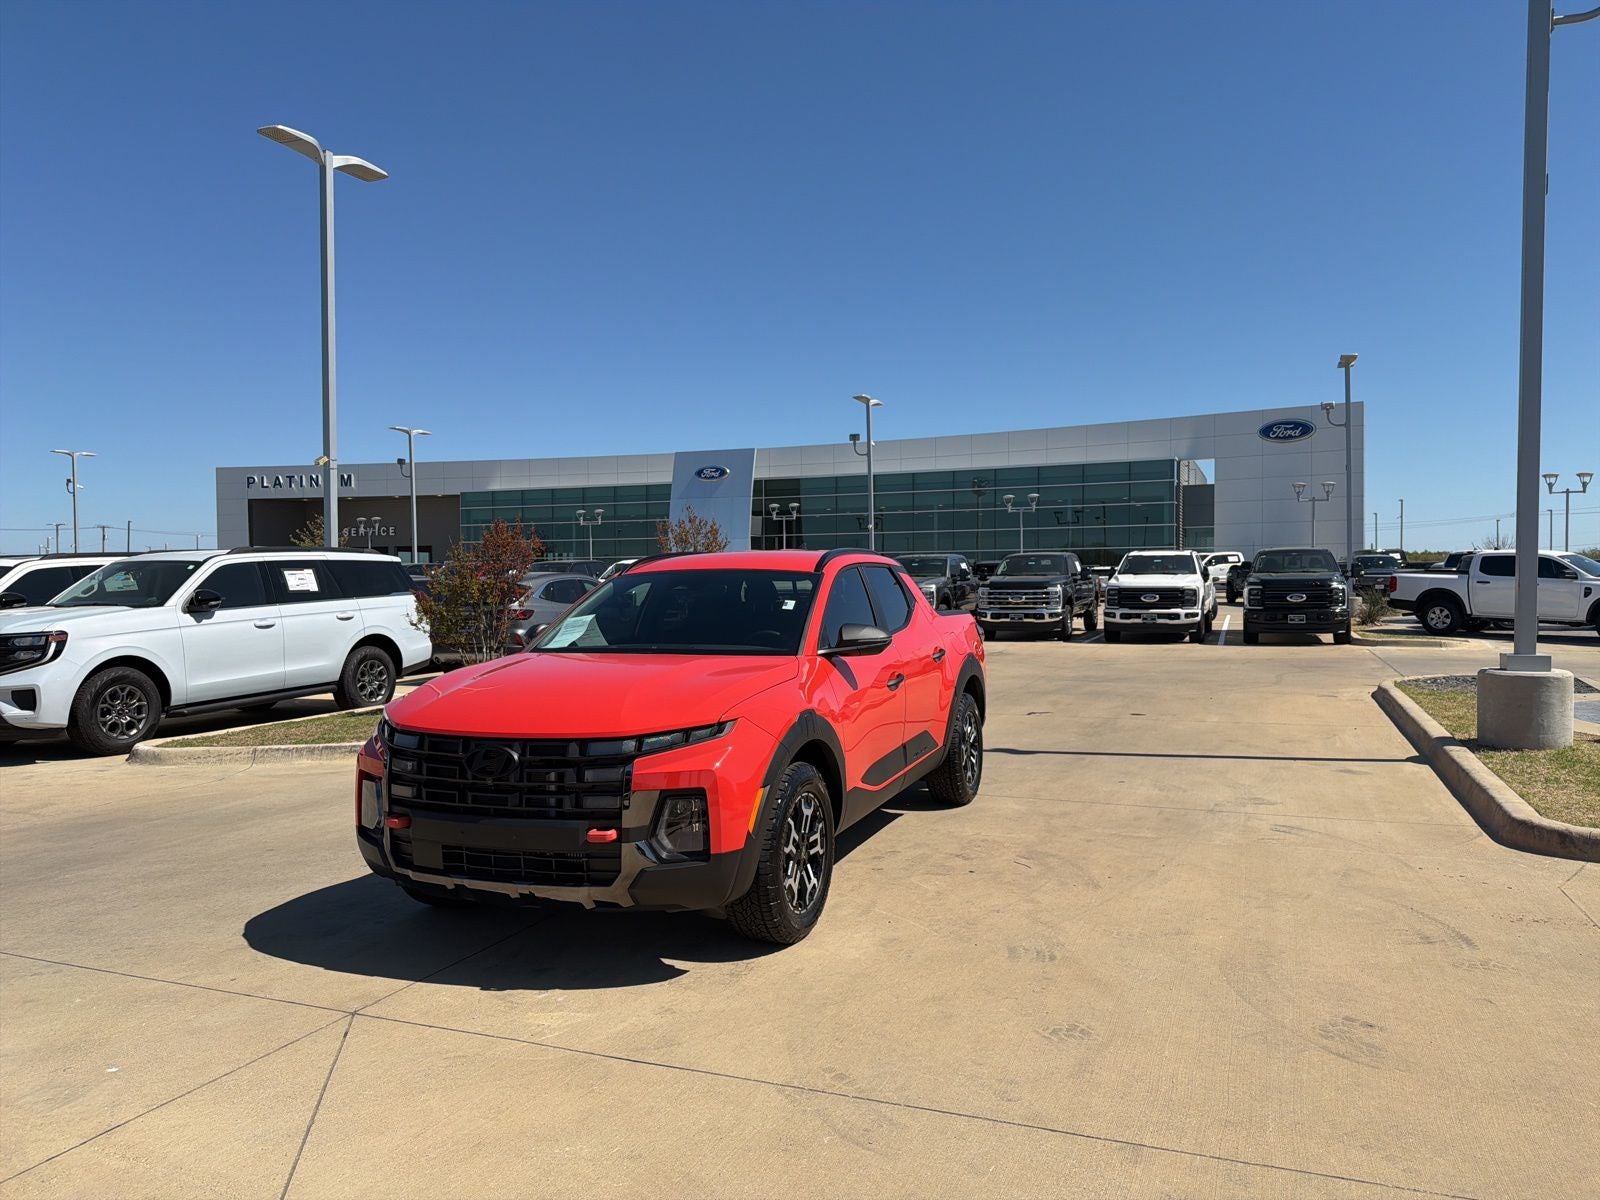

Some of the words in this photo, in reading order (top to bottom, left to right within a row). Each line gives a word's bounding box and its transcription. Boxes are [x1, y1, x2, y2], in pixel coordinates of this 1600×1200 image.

[1270, 424, 1302, 438] Ford
[701, 468, 720, 478] Ford
[247, 474, 352, 488] PLATINM
